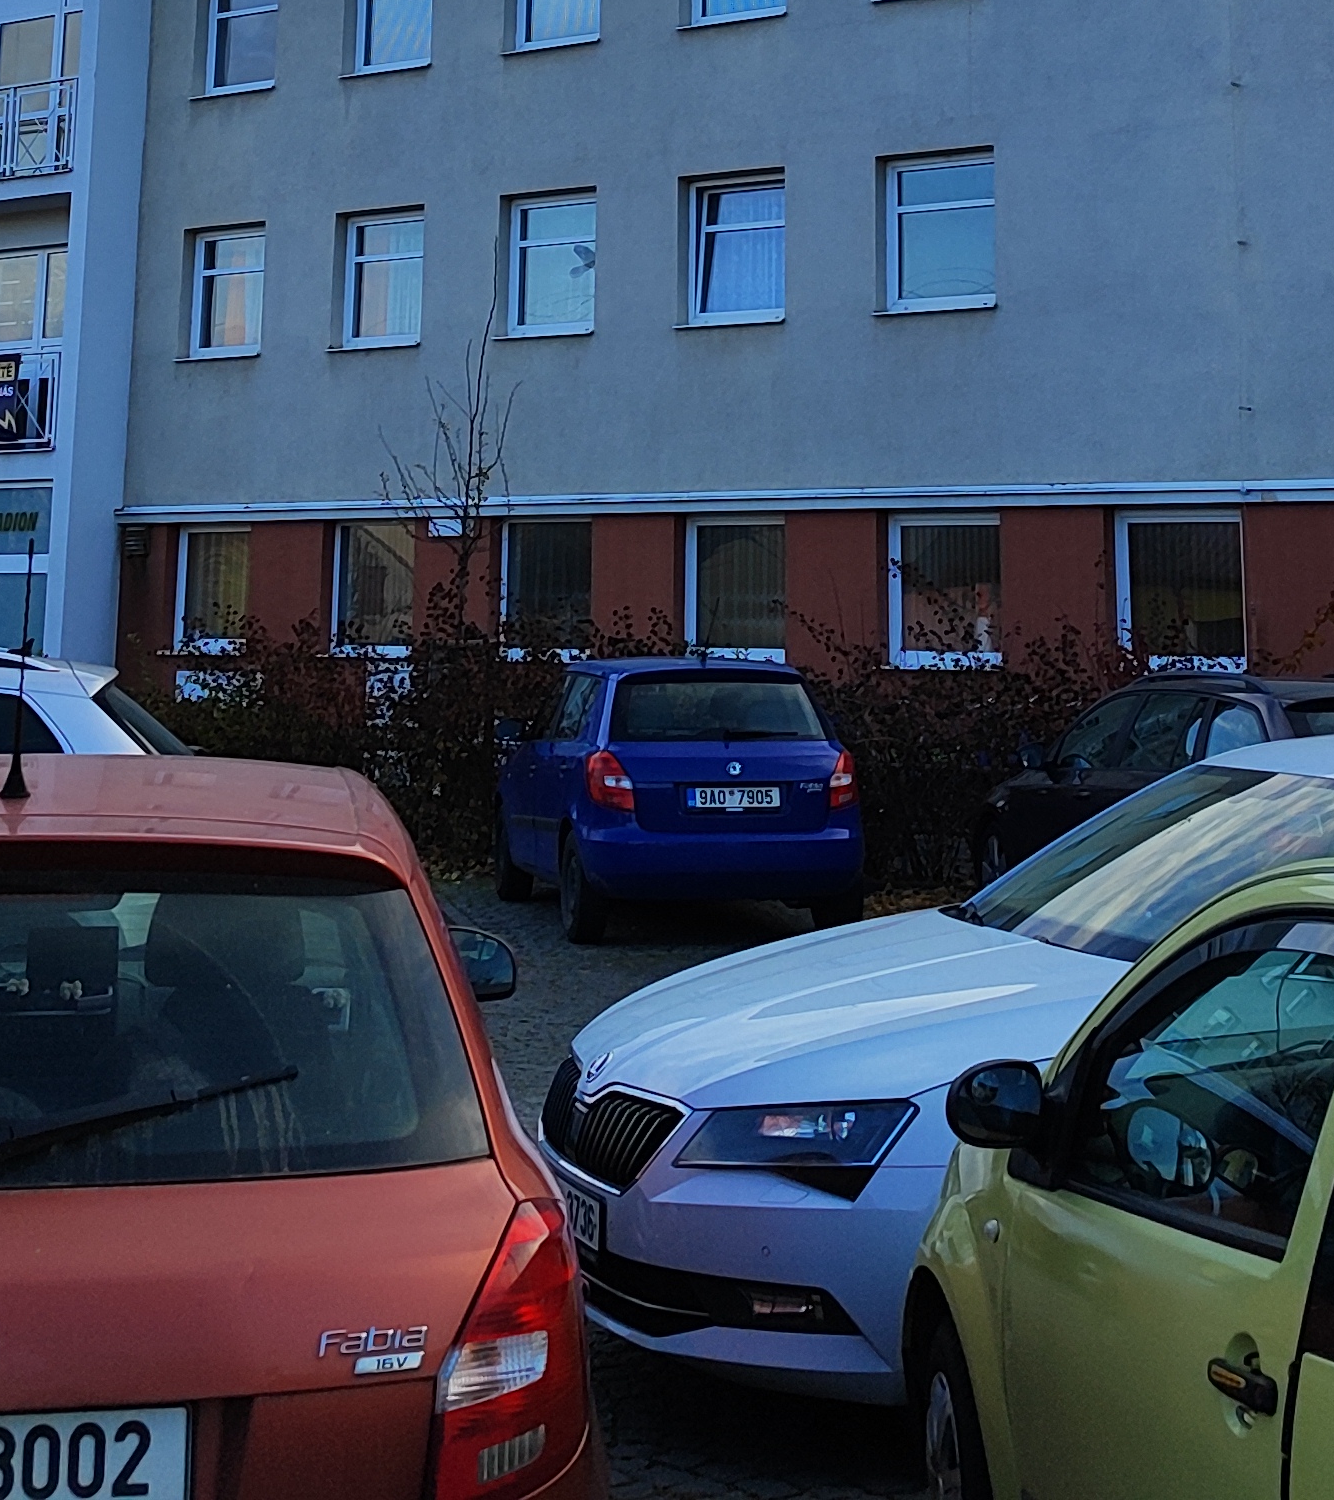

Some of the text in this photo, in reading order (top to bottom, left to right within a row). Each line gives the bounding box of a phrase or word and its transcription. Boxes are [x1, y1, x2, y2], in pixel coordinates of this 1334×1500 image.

[736, 789, 774, 805] 7905
[319, 1325, 428, 1357] Fabia
[375, 1355, 408, 1370] 16V
